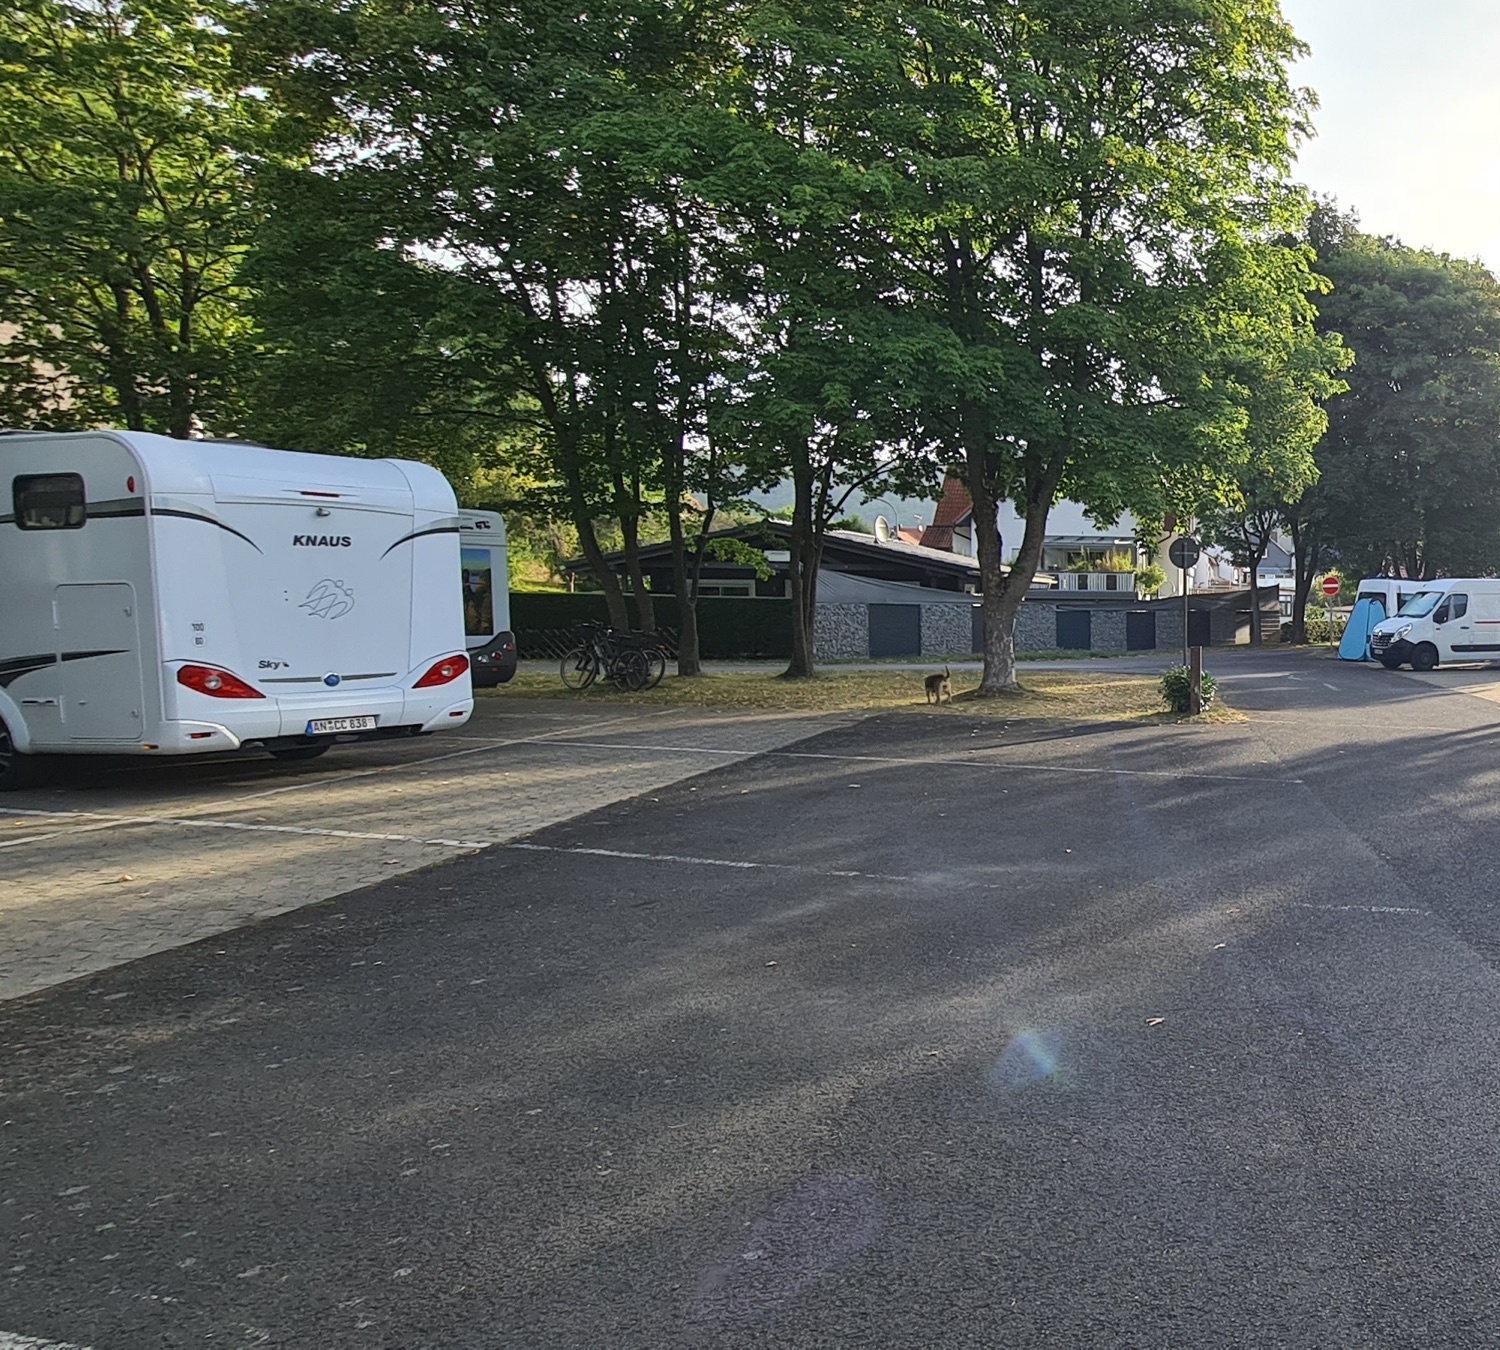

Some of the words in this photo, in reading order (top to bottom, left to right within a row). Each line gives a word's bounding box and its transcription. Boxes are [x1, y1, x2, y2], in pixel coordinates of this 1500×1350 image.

[293, 535, 351, 547] KNAUS
[258, 660, 280, 670] Sky
[314, 721, 327, 731] AN
[334, 720, 347, 730] CC
[350, 718, 368, 729] 838
